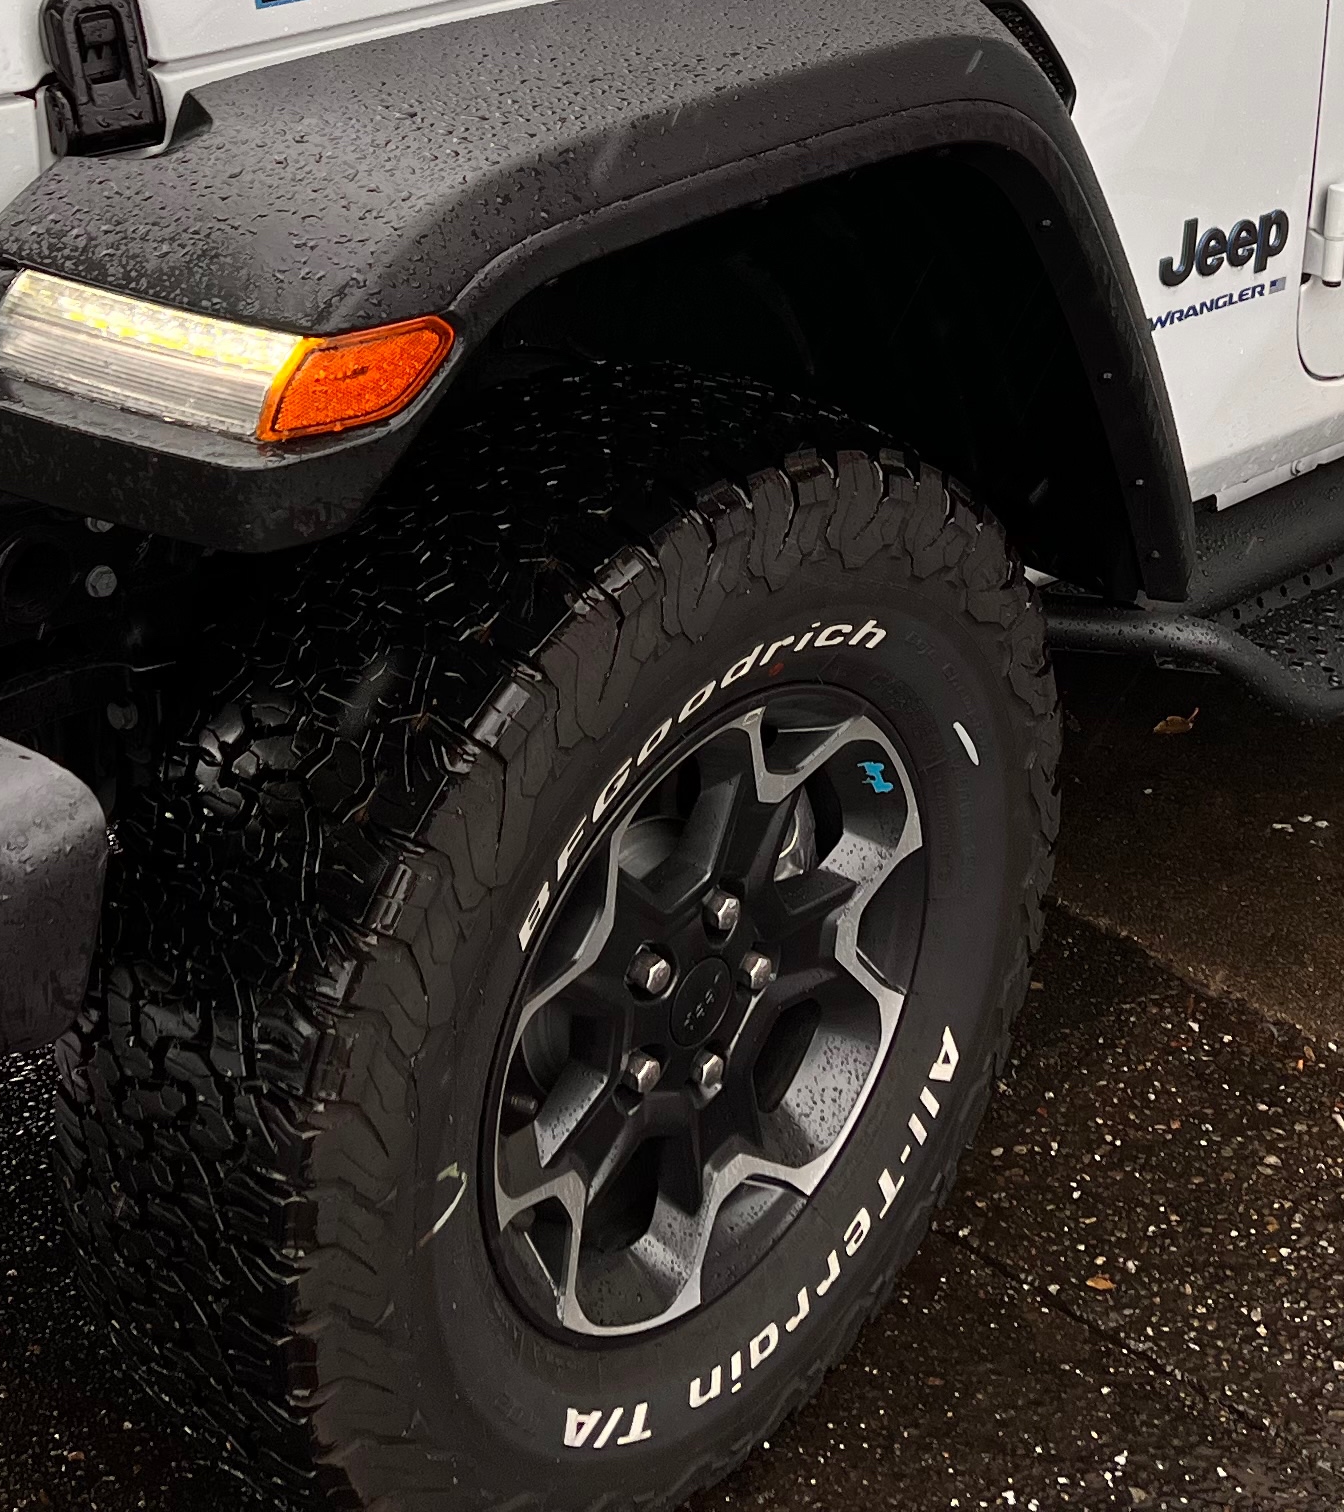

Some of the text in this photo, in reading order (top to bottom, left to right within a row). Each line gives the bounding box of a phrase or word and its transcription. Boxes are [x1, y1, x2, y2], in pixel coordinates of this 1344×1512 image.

[1158, 208, 1290, 288] Jeep
[1150, 283, 1266, 331] WRANGLER
[517, 619, 887, 952] BFGoodrich
[688, 1026, 960, 1408] All-Terrain
[563, 1401, 653, 1449] T/A
